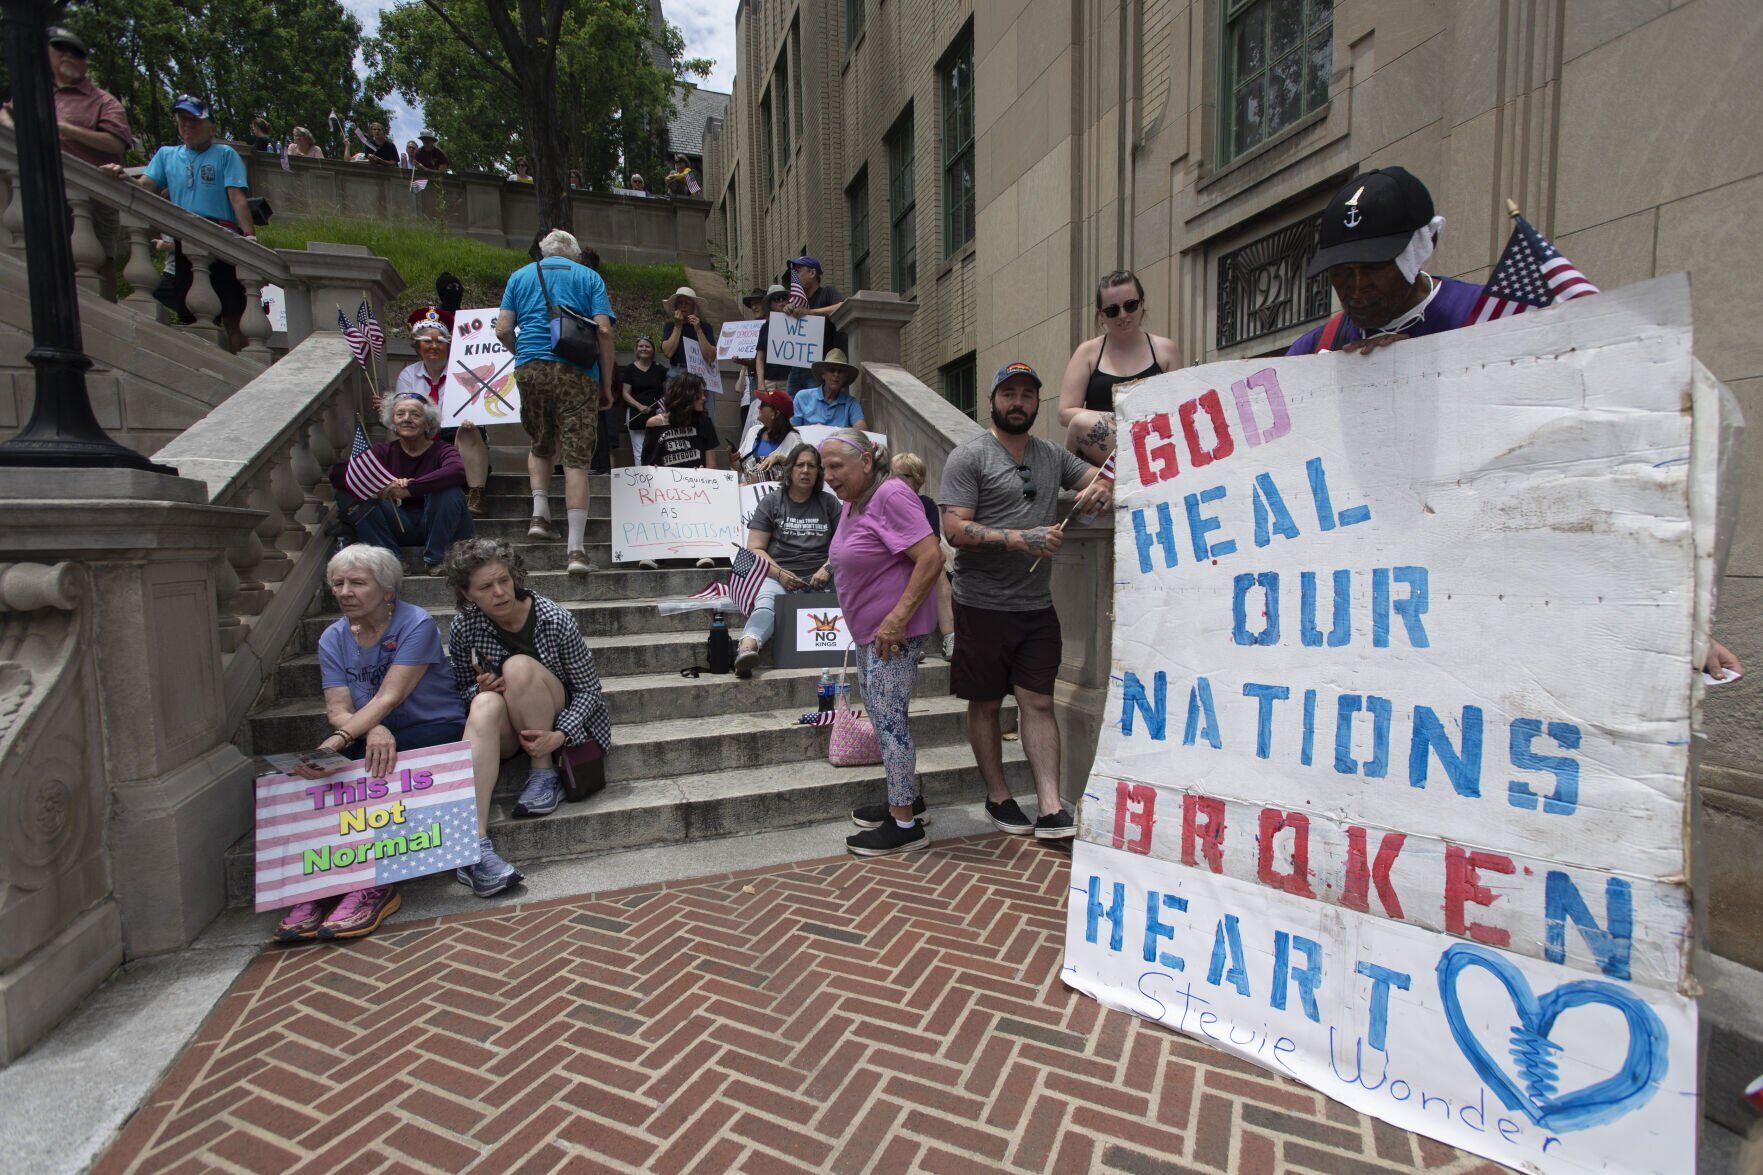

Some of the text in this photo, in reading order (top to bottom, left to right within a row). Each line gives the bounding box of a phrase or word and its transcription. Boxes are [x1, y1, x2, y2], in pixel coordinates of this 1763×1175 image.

[457, 318, 483, 337] NO
[784, 318, 809, 337] WE
[464, 342, 509, 356] KINGS
[772, 339, 818, 363] VOTE
[1129, 367, 1292, 488] GOD
[624, 468, 719, 489] Stop Disguising
[638, 488, 711, 505] RACISM
[660, 507, 678, 519] AS
[1130, 456, 1371, 574] HEAL
[1232, 565, 1431, 648] OUR
[815, 631, 837, 642] NO
[1121, 670, 1583, 816] NATIONS
[306, 769, 434, 811] This Is
[339, 800, 406, 836] Not
[302, 822, 442, 876] Normal
[1113, 780, 1633, 981] BROKEN
[1085, 875, 1411, 1052] HEART
[1130, 971, 1562, 1154] Stevie Wonder
